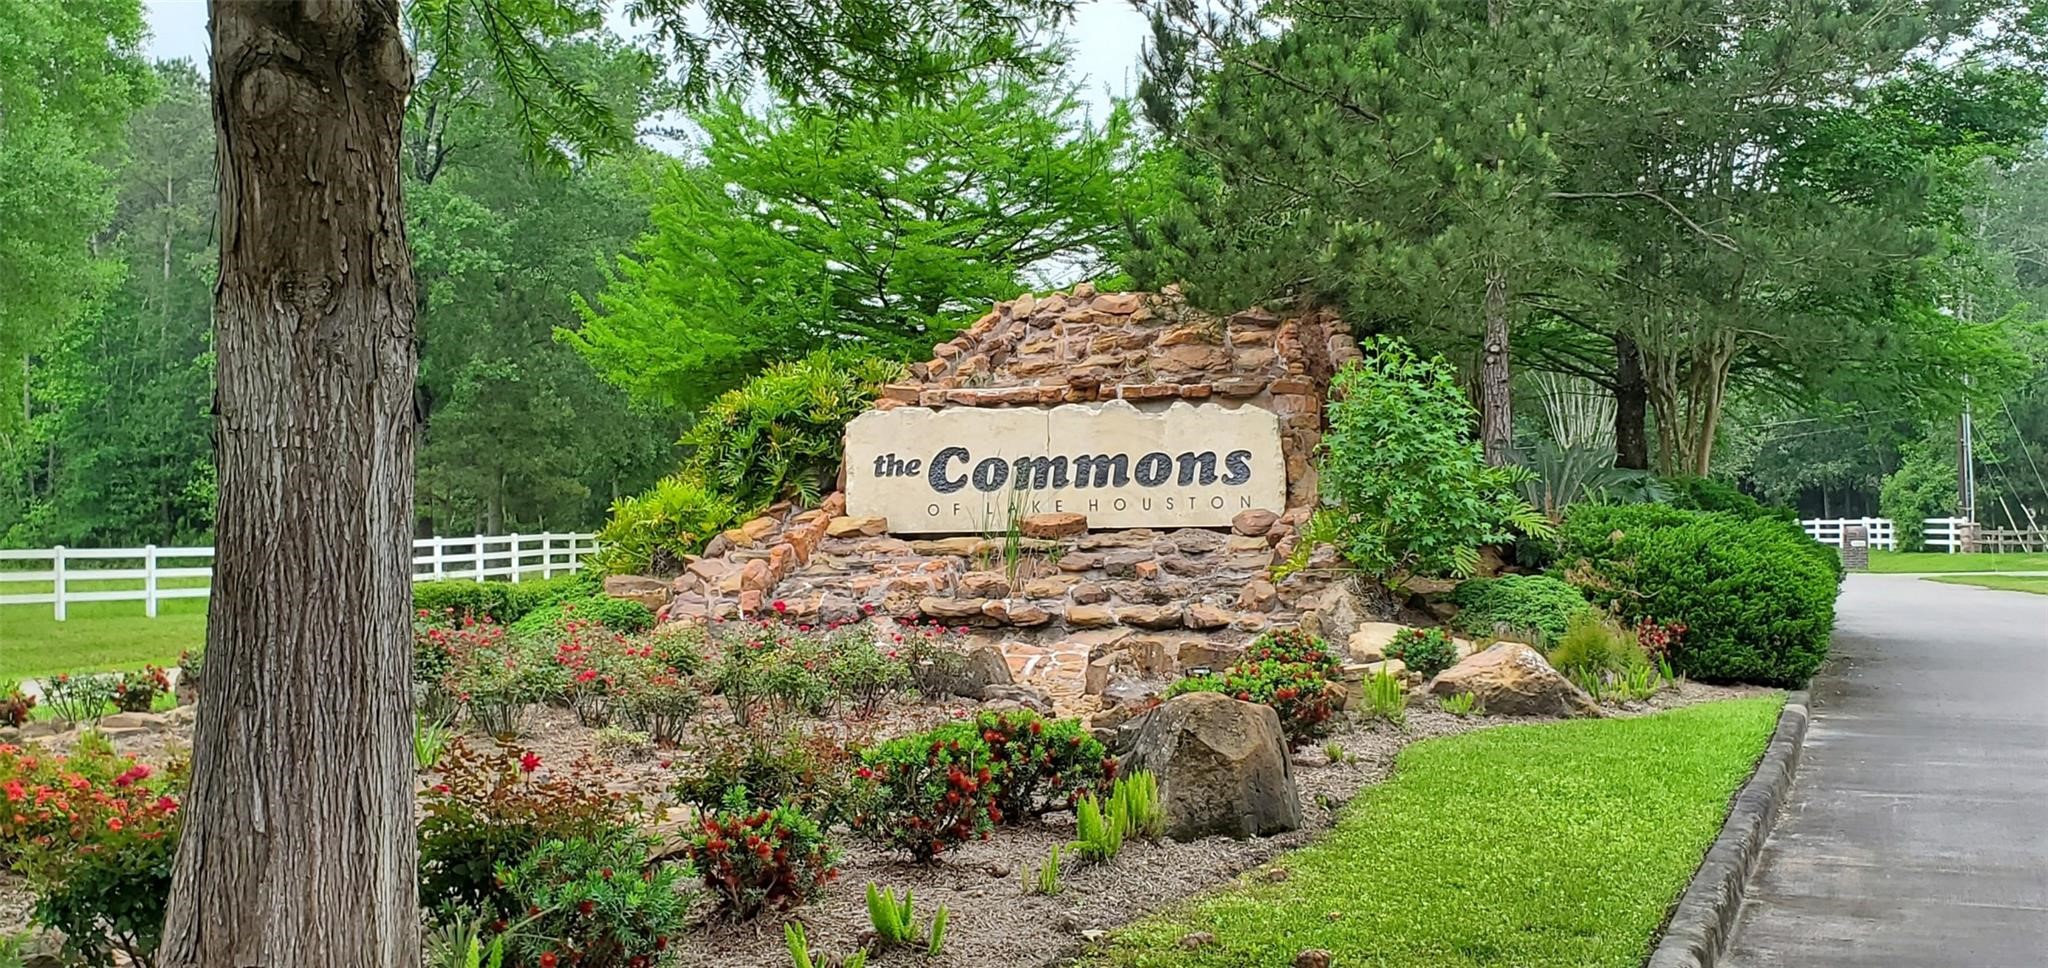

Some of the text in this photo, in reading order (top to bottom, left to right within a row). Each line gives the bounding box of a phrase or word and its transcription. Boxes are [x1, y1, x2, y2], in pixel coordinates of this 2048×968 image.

[873, 446, 1252, 494] the Commons
[927, 495, 1252, 517] OF LAKE HOUSTON
